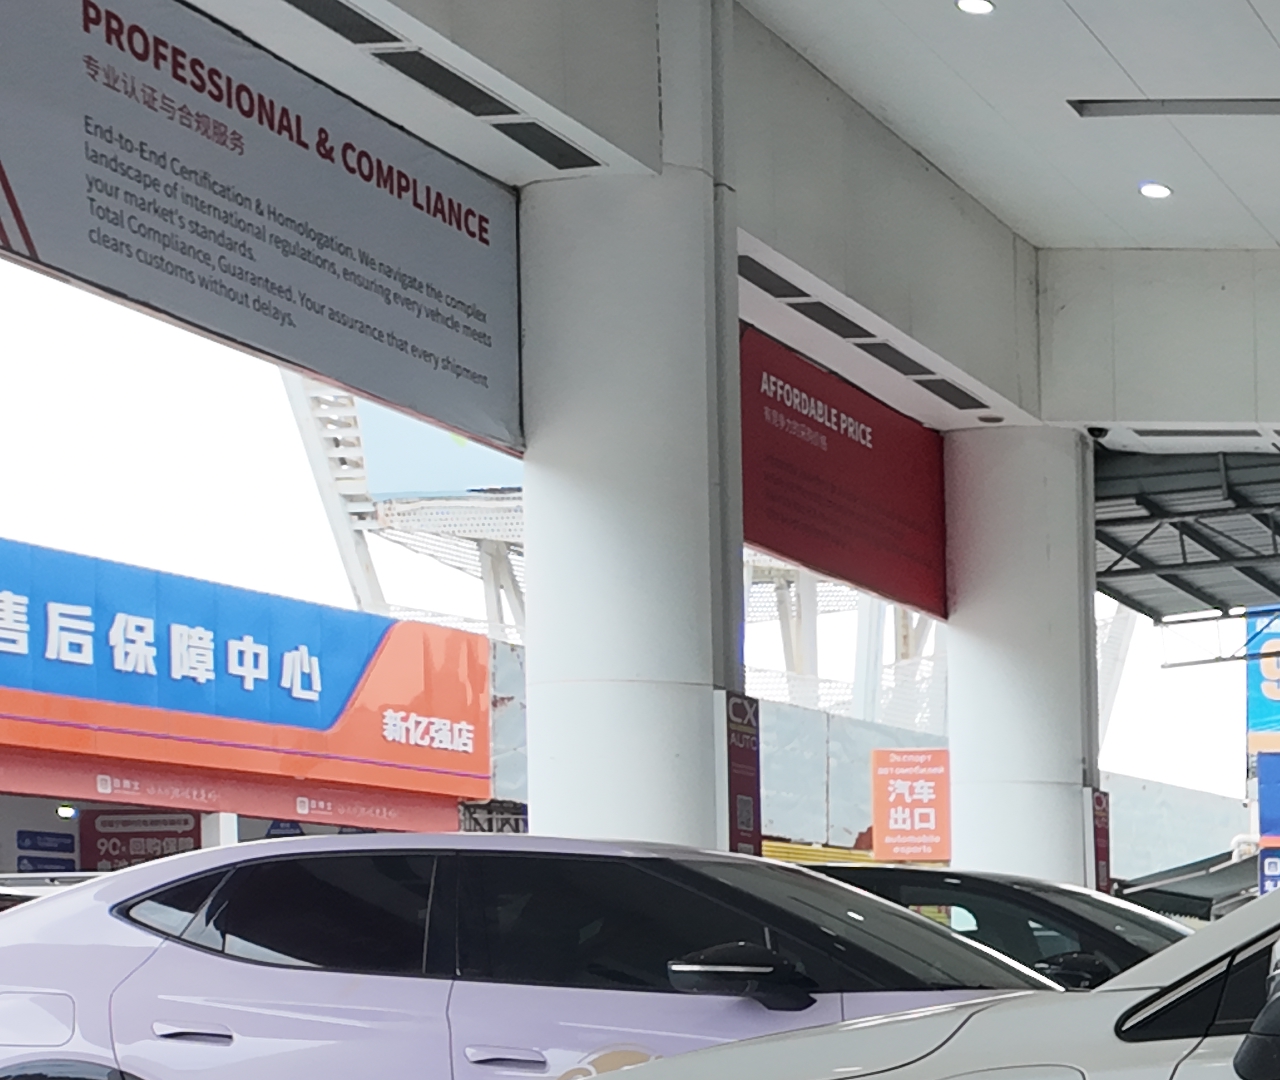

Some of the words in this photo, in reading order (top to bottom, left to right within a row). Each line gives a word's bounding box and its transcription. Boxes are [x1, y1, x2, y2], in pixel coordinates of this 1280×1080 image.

[82, 0, 309, 150] PROFESSIONAL
[316, 127, 335, 163] &
[342, 142, 490, 246] COMPLIANCE
[83, 54, 244, 156] 专业认证与合规服务
[84, 115, 167, 170] End-to-End
[170, 157, 252, 211] Certification
[255, 198, 264, 216] &
[267, 203, 357, 262] Homologation.
[357, 248, 377, 271] We
[378, 261, 424, 294] navigate
[425, 282, 443, 302] the
[444, 293, 487, 324] complex
[84, 141, 160, 193] landscape
[163, 181, 179, 200] of
[181, 186, 266, 242] international
[269, 231, 341, 279] regulations,
[342, 266, 391, 305] ensuring
[393, 290, 423, 318] every
[423, 304, 460, 332] vehicle
[461, 323, 492, 348] meets
[86, 174, 120, 201] your
[124, 190, 186, 230] market's
[188, 220, 257, 262] standards.
[87, 196, 124, 229] Total
[127, 214, 216, 271] Compliance,
[217, 255, 297, 305] Guaranteed.
[297, 289, 326, 316] Your
[327, 306, 385, 343] assurance
[386, 330, 410, 354] that
[411, 344, 440, 370] every
[88, 226, 133, 258] clears
[135, 248, 196, 284] customs
[198, 274, 251, 308] without
[252, 296, 297, 328] delays.
[760, 371, 838, 431] AFFORDABLE
[840, 412, 873, 449] PRICE
[0, 590, 322, 701] 售后保障中心
[382, 708, 475, 753] 新亿强店
[728, 697, 757, 727] CX
[730, 733, 758, 750] AUTO
[887, 779, 936, 803] 汽车
[889, 806, 936, 830] 出口
